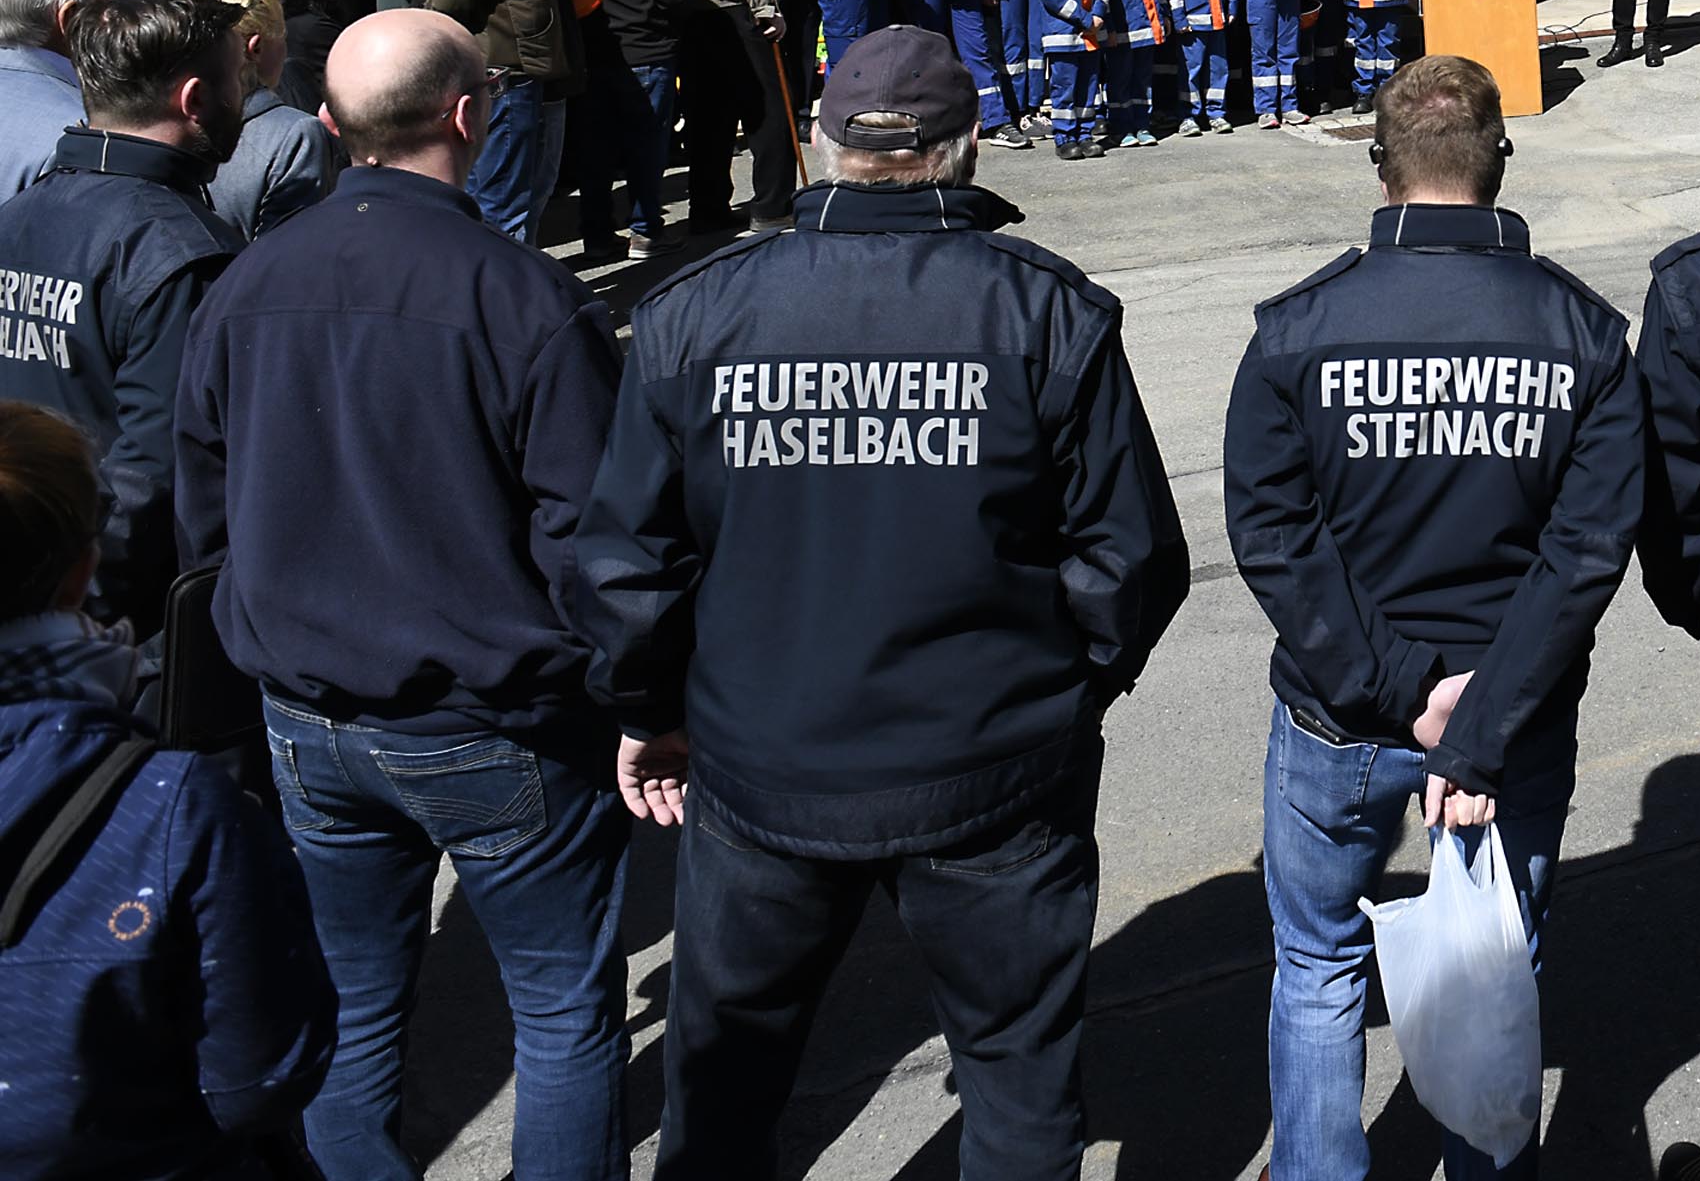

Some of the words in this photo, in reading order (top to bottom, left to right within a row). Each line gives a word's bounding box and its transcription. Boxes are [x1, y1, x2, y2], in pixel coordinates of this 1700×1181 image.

[711, 361, 989, 414] FEUERWEHR
[1320, 356, 1576, 412] FEUERWEHR
[723, 416, 980, 469] HASELBACH
[1346, 409, 1546, 460] STEINACH
